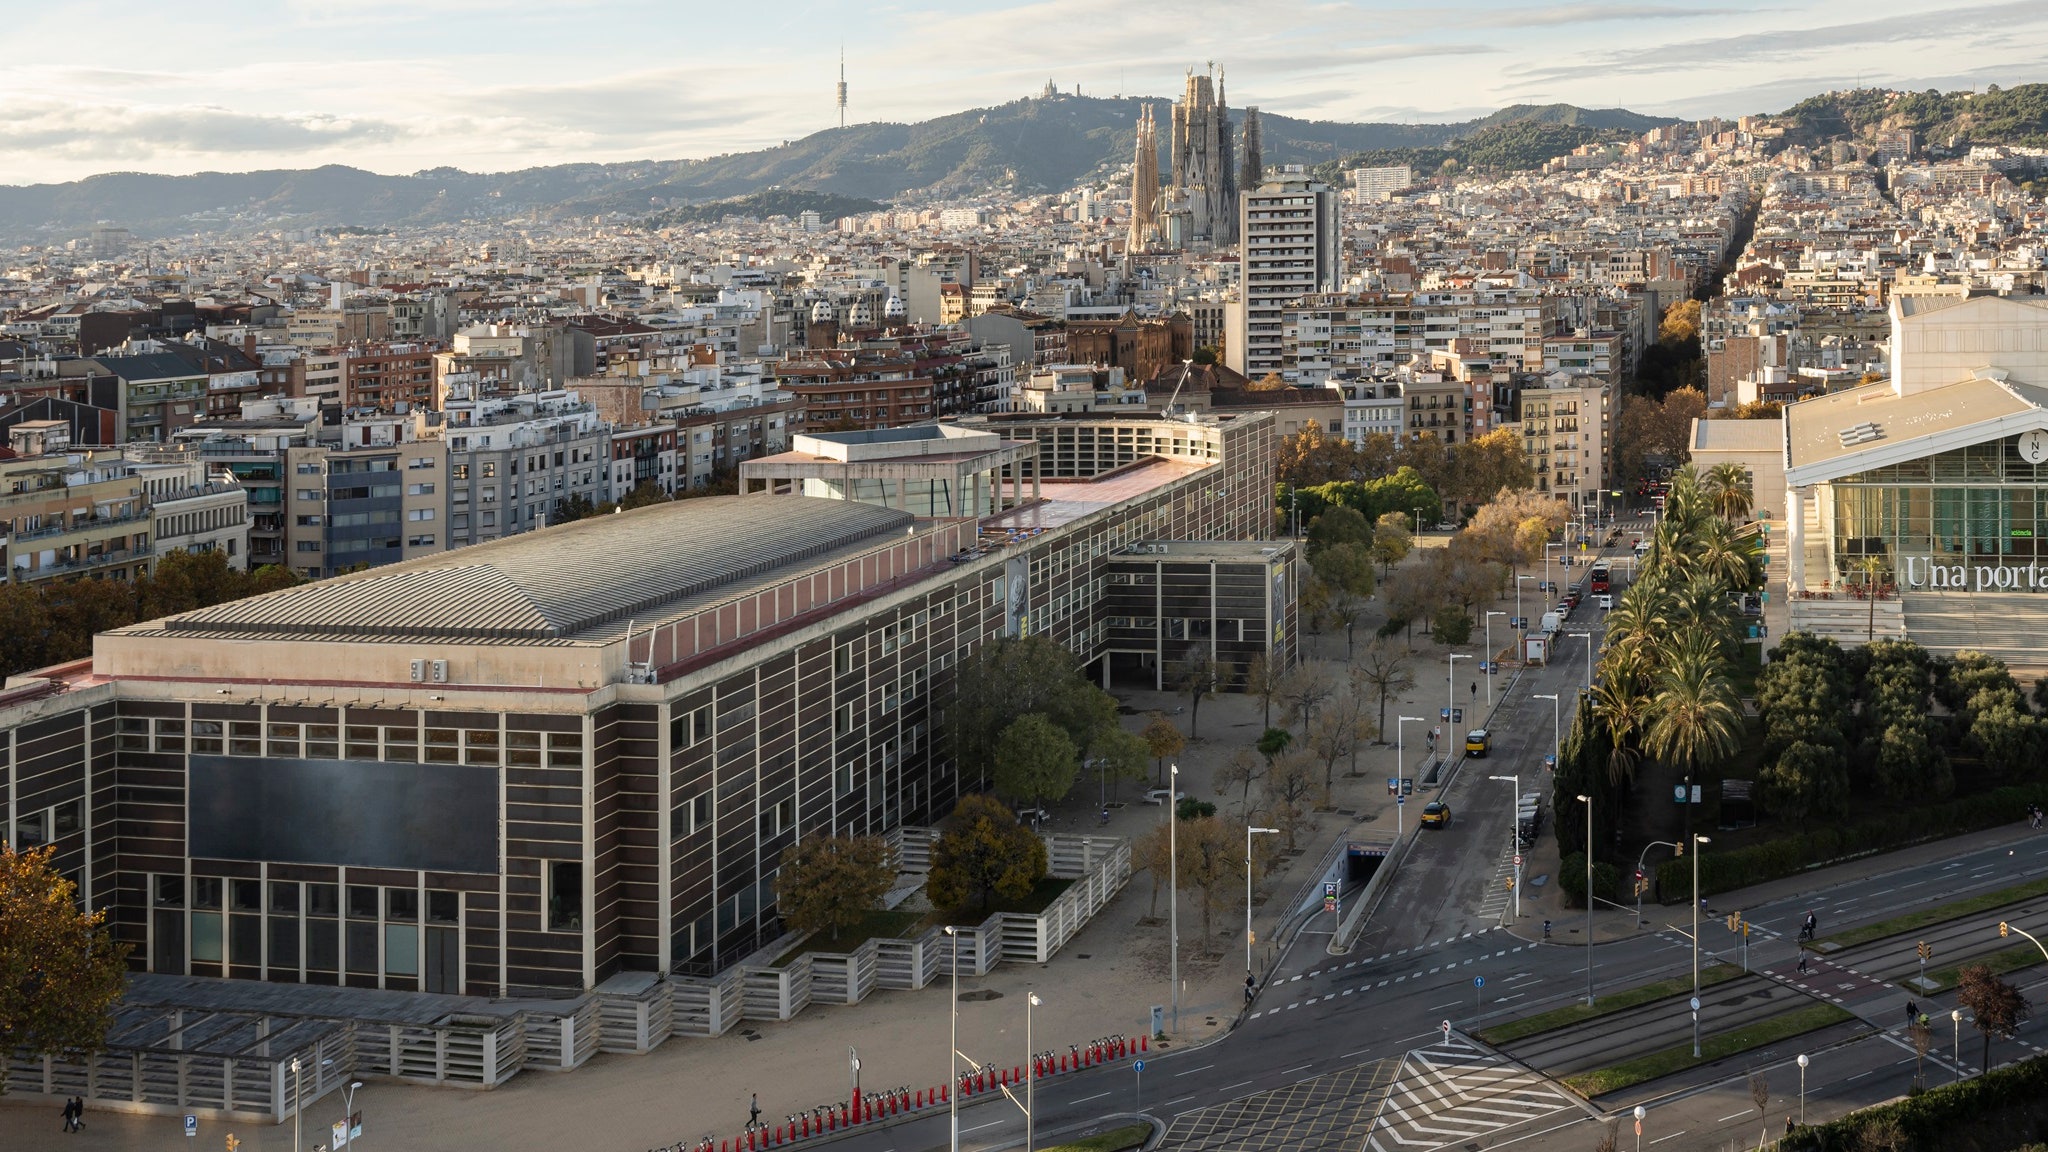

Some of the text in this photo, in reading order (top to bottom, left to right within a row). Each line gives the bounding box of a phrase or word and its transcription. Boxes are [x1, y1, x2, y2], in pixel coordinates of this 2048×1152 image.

[2031, 432, 2040, 460] TNC
[1905, 556, 2048, 592] Una porta
[1326, 884, 1334, 895] P
[187, 1116, 195, 1127] P
